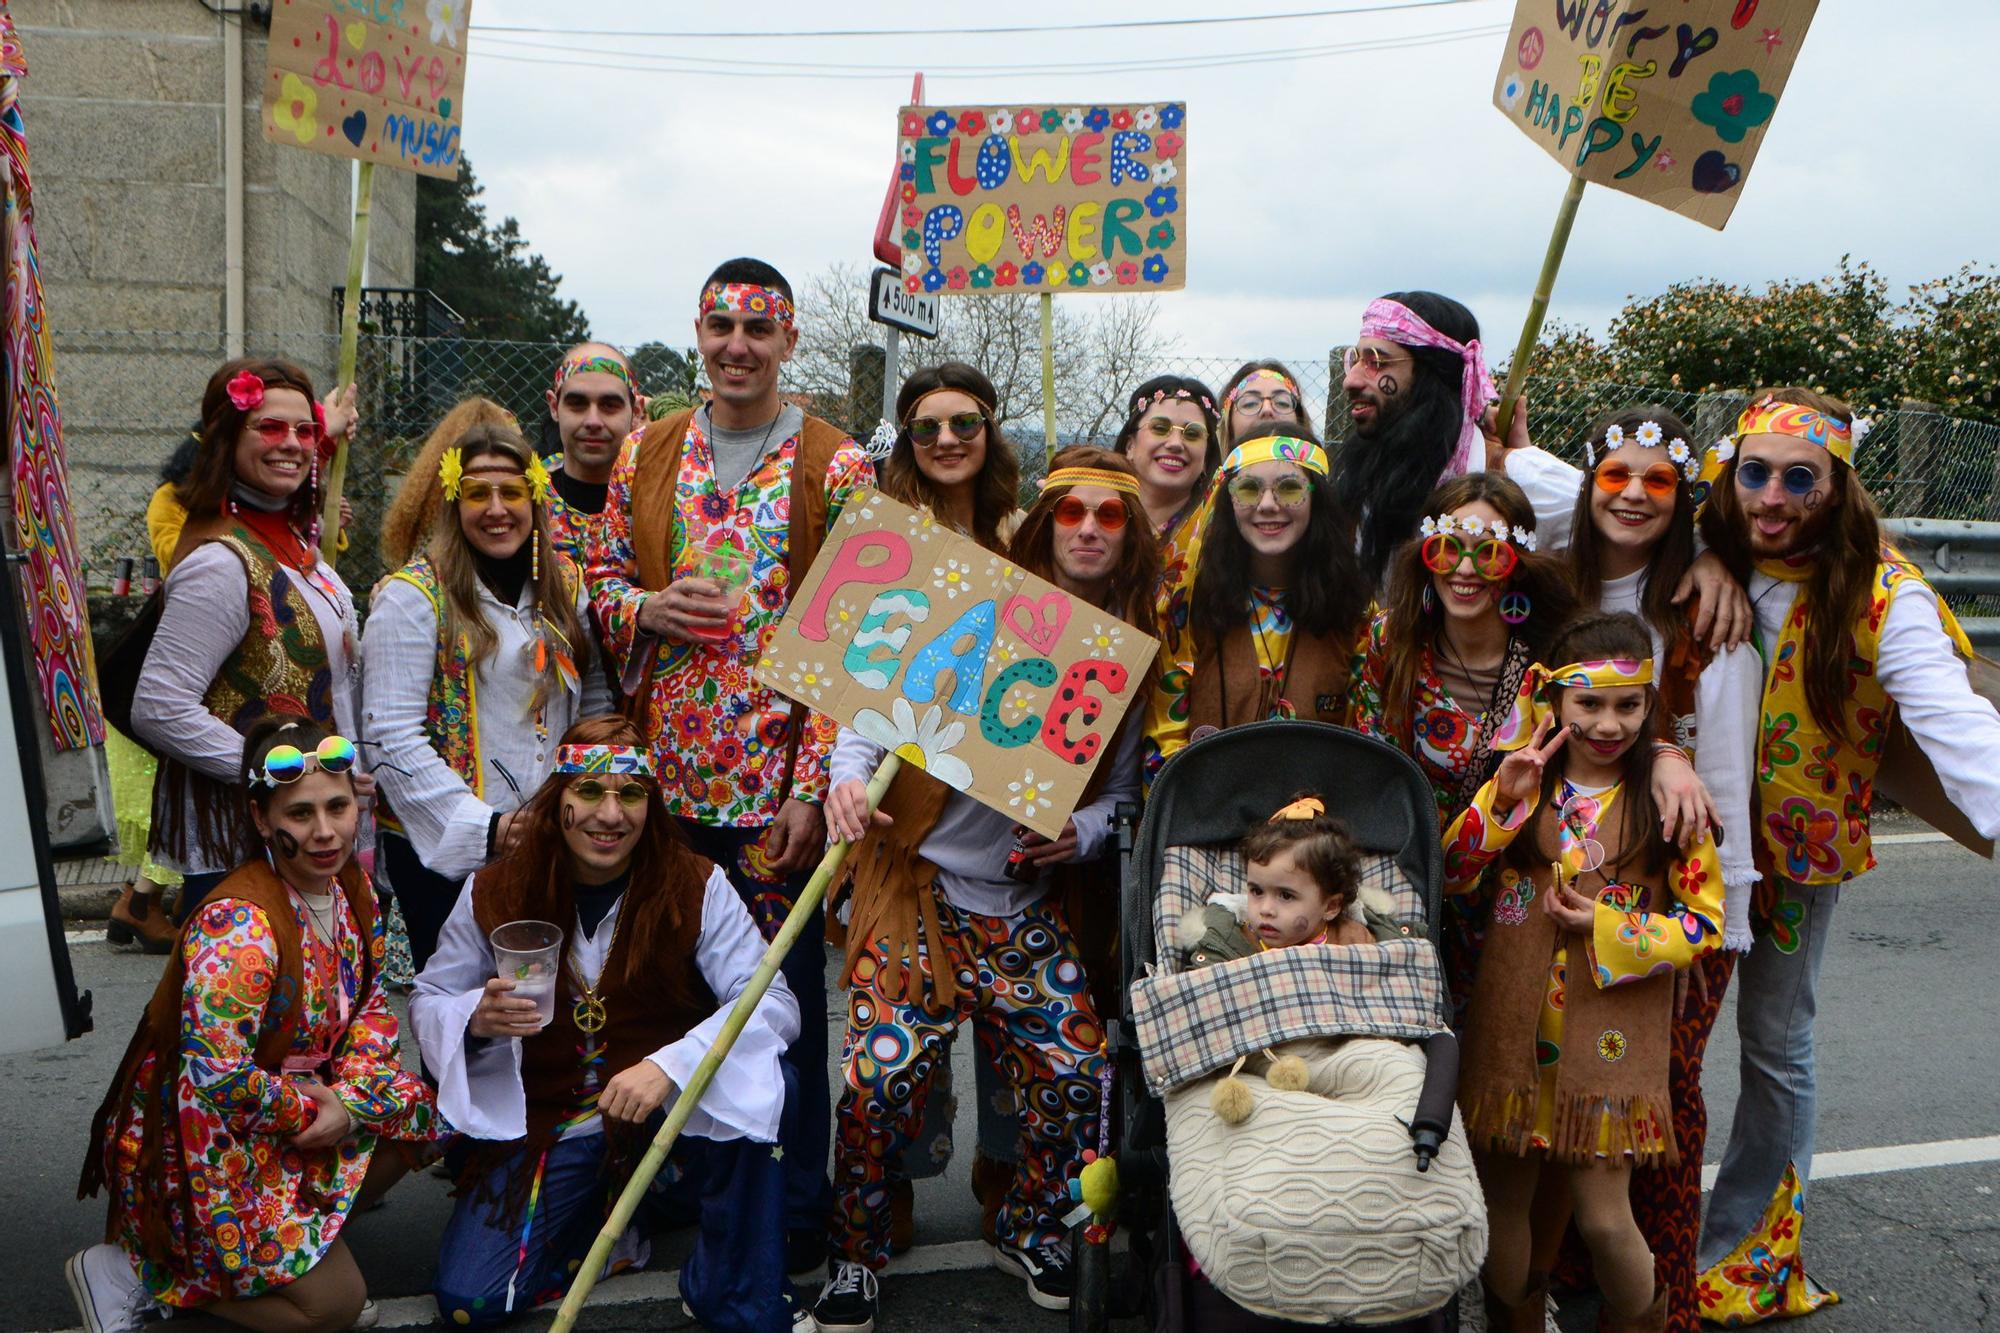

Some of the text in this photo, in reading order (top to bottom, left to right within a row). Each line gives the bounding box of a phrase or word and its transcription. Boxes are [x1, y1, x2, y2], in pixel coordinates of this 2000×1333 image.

[1570, 53, 1657, 123] BE
[914, 131, 1152, 196] FLOWER
[1524, 79, 1662, 179] HAPPY
[923, 198, 1145, 267] POWER
[893, 286, 927, 322] 500 m
[798, 530, 1129, 765] PEACE
